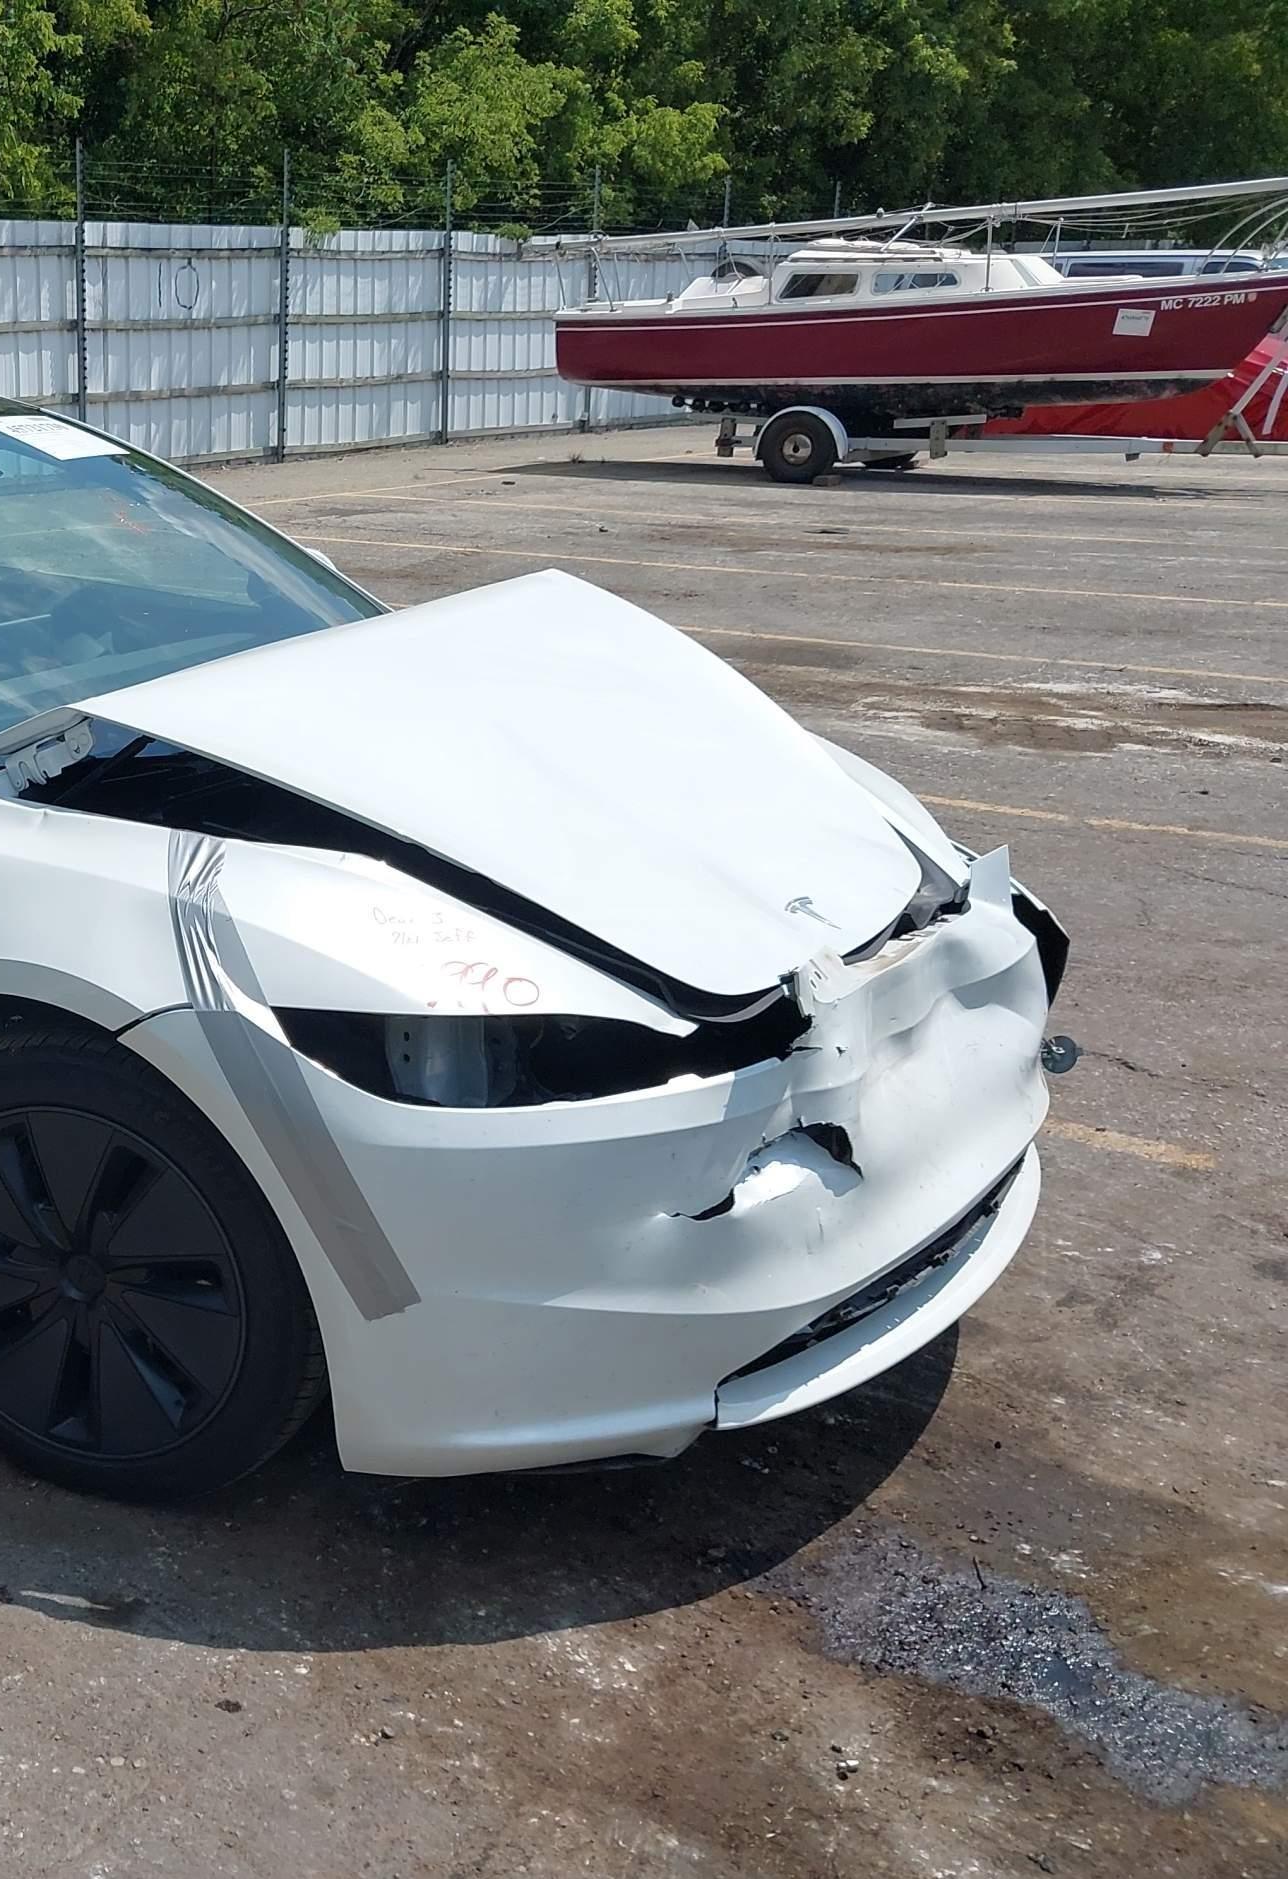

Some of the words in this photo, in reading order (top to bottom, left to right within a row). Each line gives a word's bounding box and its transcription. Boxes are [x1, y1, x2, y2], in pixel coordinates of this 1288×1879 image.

[1160, 299, 1184, 311] MC
[1187, 295, 1222, 309] 7222
[1223, 292, 1246, 305] PM
